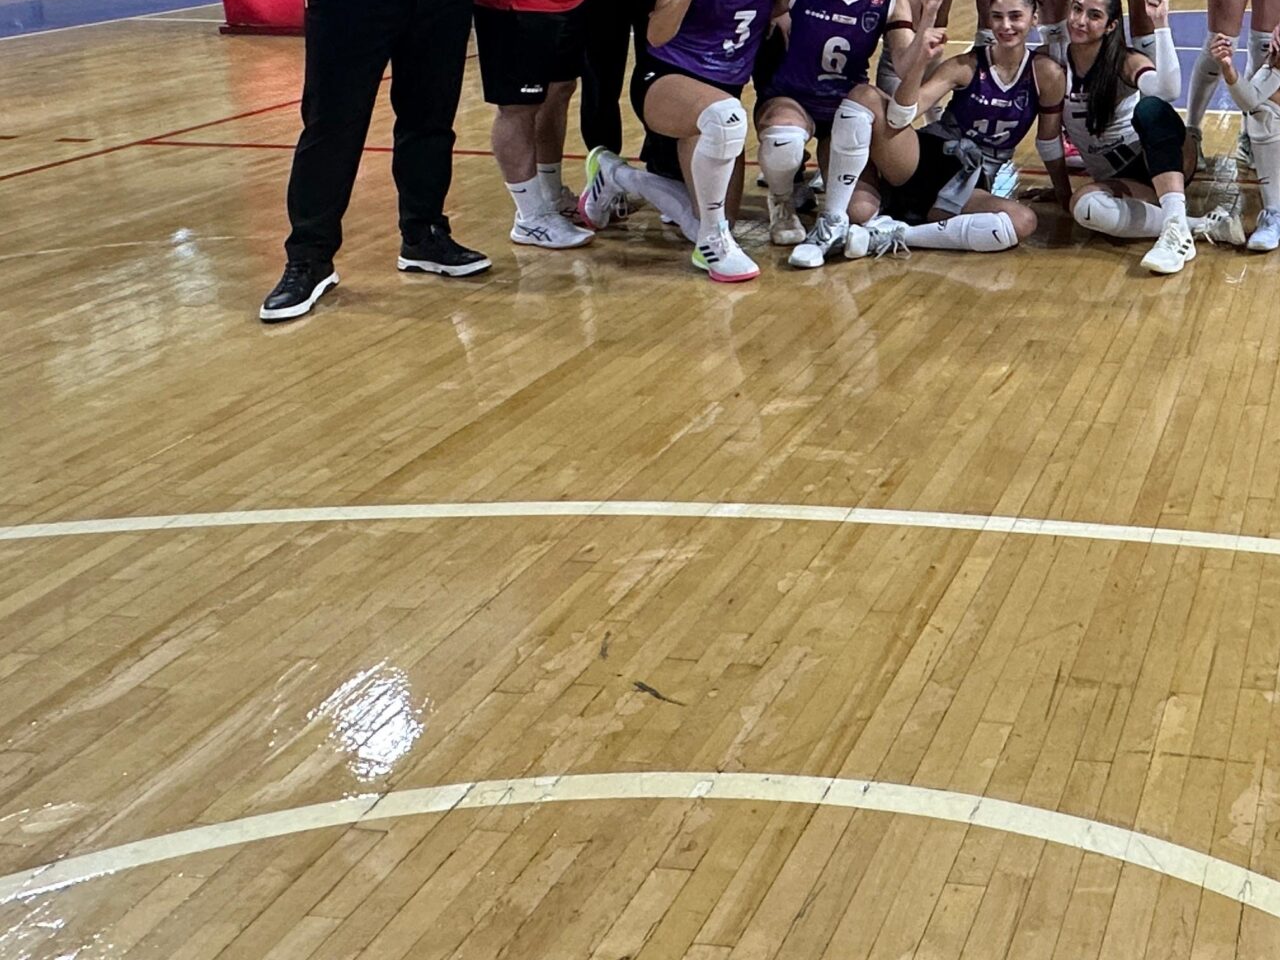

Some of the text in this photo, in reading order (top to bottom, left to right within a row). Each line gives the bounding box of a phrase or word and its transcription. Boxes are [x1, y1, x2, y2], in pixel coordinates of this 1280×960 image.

[723, 9, 757, 50] 3
[818, 36, 851, 81] 6
[966, 119, 1020, 146] 15
